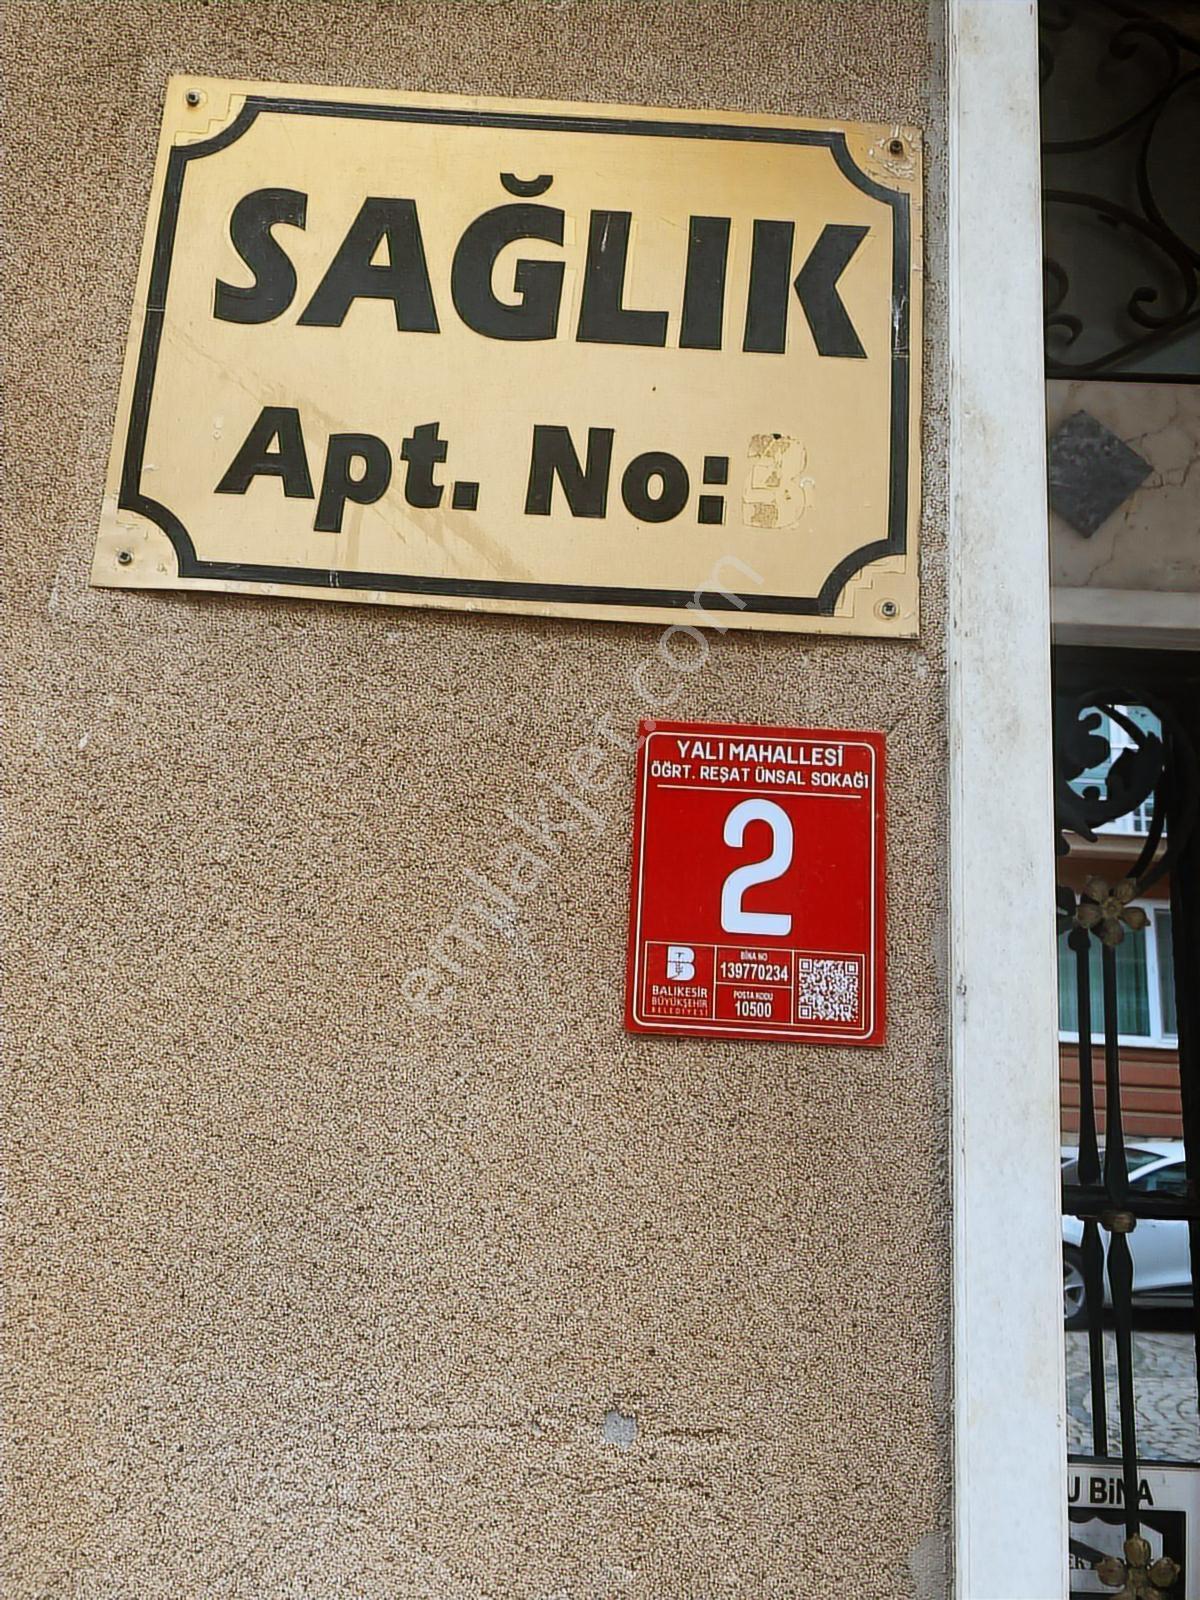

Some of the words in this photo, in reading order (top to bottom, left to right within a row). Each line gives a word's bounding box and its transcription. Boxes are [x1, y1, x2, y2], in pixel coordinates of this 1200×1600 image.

[213, 172, 872, 359] SAĞLIK
[213, 406, 479, 533] Apt.
[677, 740, 723, 761] YALI
[729, 742, 844, 768] MAHALLESİ
[651, 760, 696, 780] ÖĞRT.
[700, 765, 750, 784] REŞAT
[755, 766, 806, 786] ÜNSAL
[811, 771, 869, 790] SOKAĞI
[720, 798, 794, 936] 2
[720, 961, 789, 982] 139770234
[652, 984, 708, 998] BALIKESİR
[735, 1001, 772, 1017] 10500
